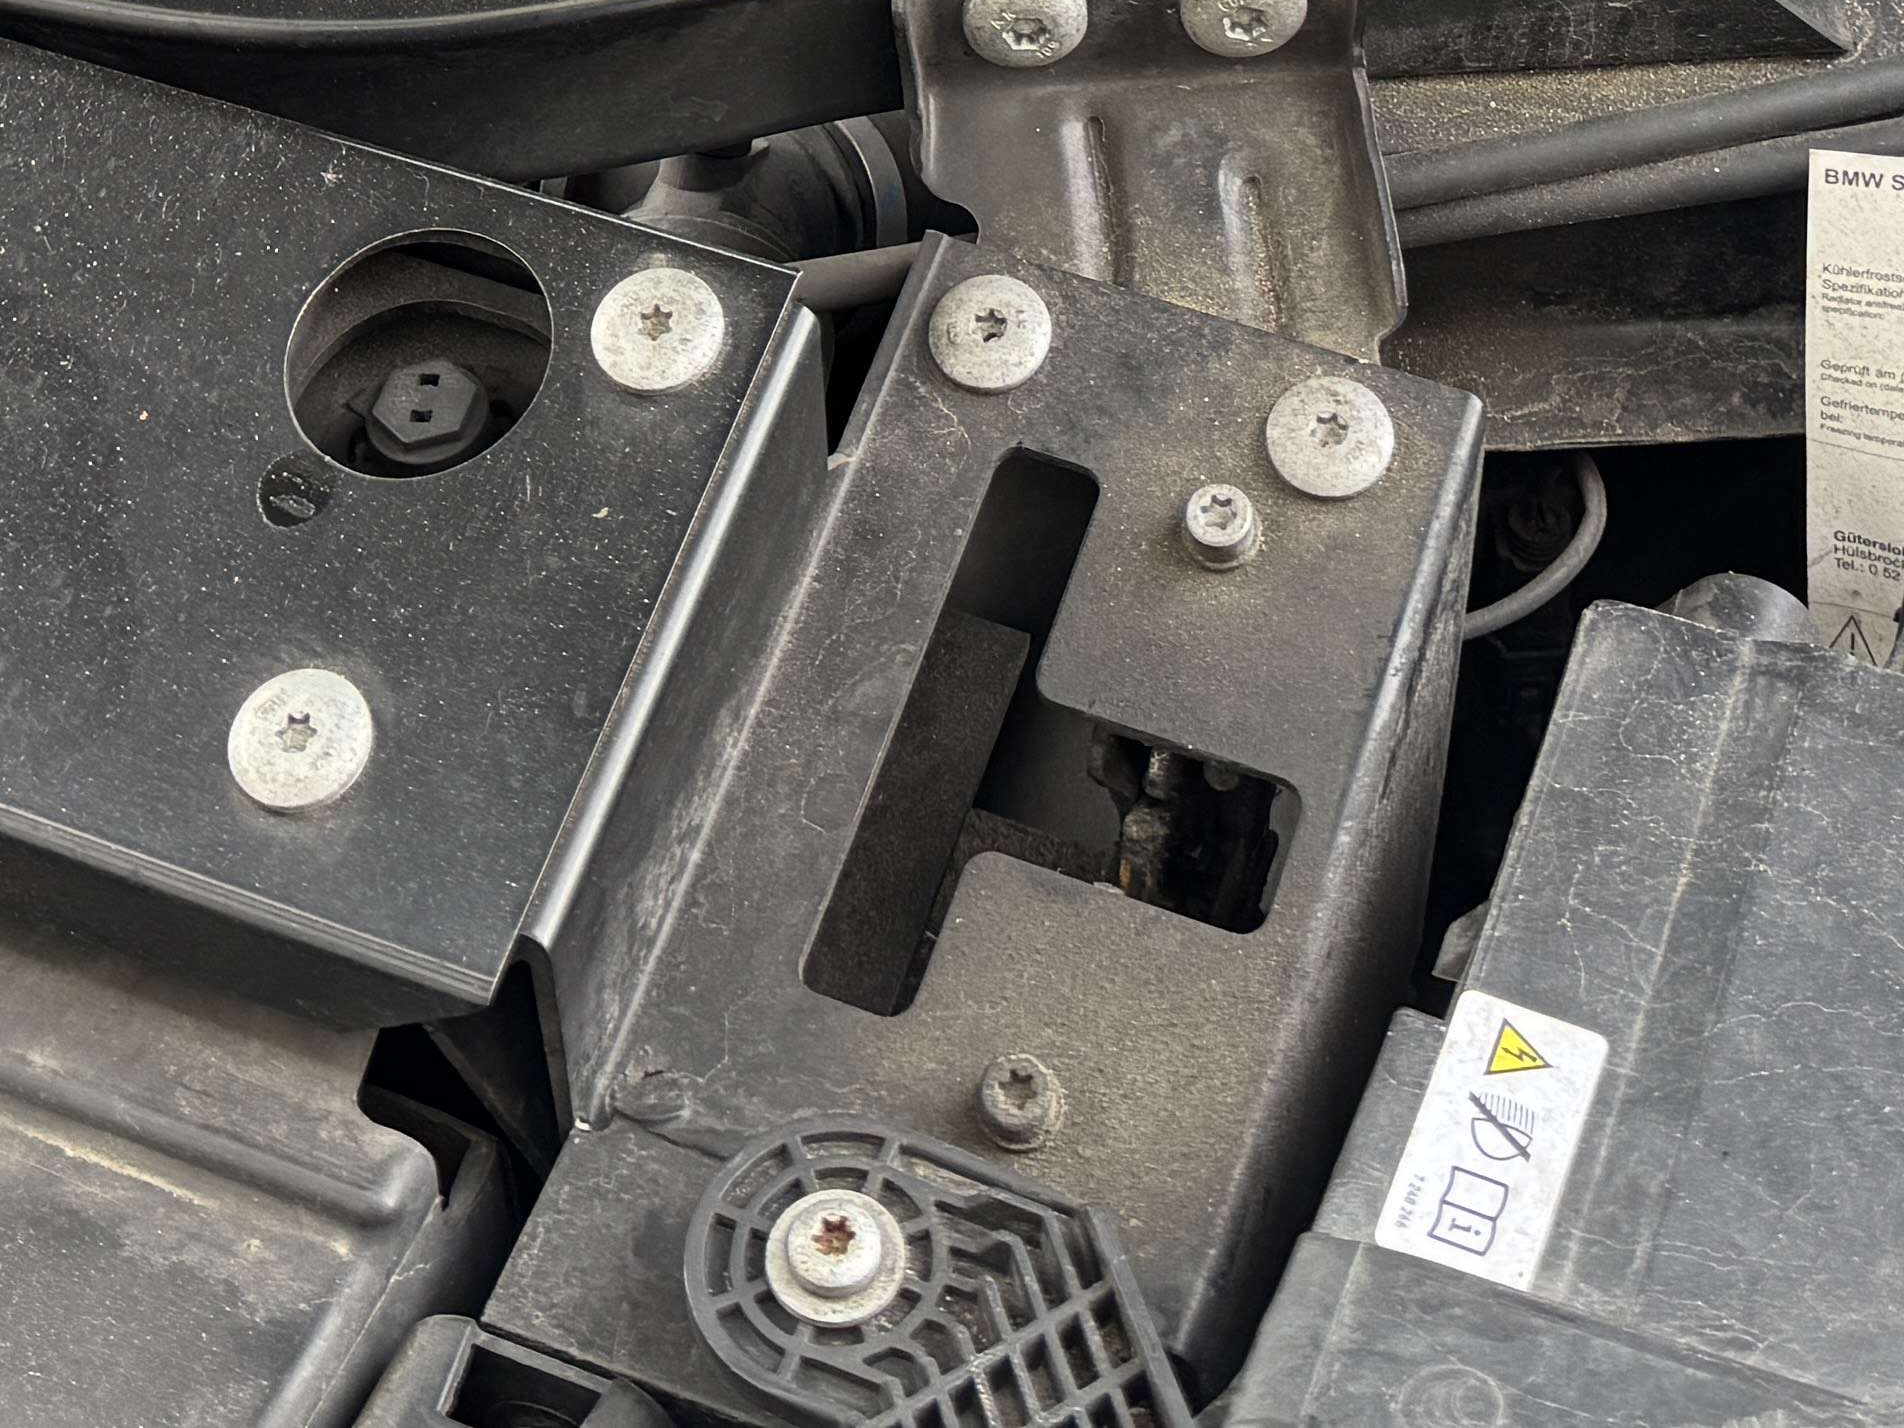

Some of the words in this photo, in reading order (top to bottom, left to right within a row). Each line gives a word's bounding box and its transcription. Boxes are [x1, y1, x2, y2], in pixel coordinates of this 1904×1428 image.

[1823, 168, 1884, 190] BMW
[1820, 359, 1870, 378] Geprüft
[1875, 369, 1896, 380] am
[1820, 410, 1843, 423] bei:
[1834, 557, 1865, 572] Tel.:
[1868, 563, 1878, 576] 0
[1882, 566, 1901, 581] 52
